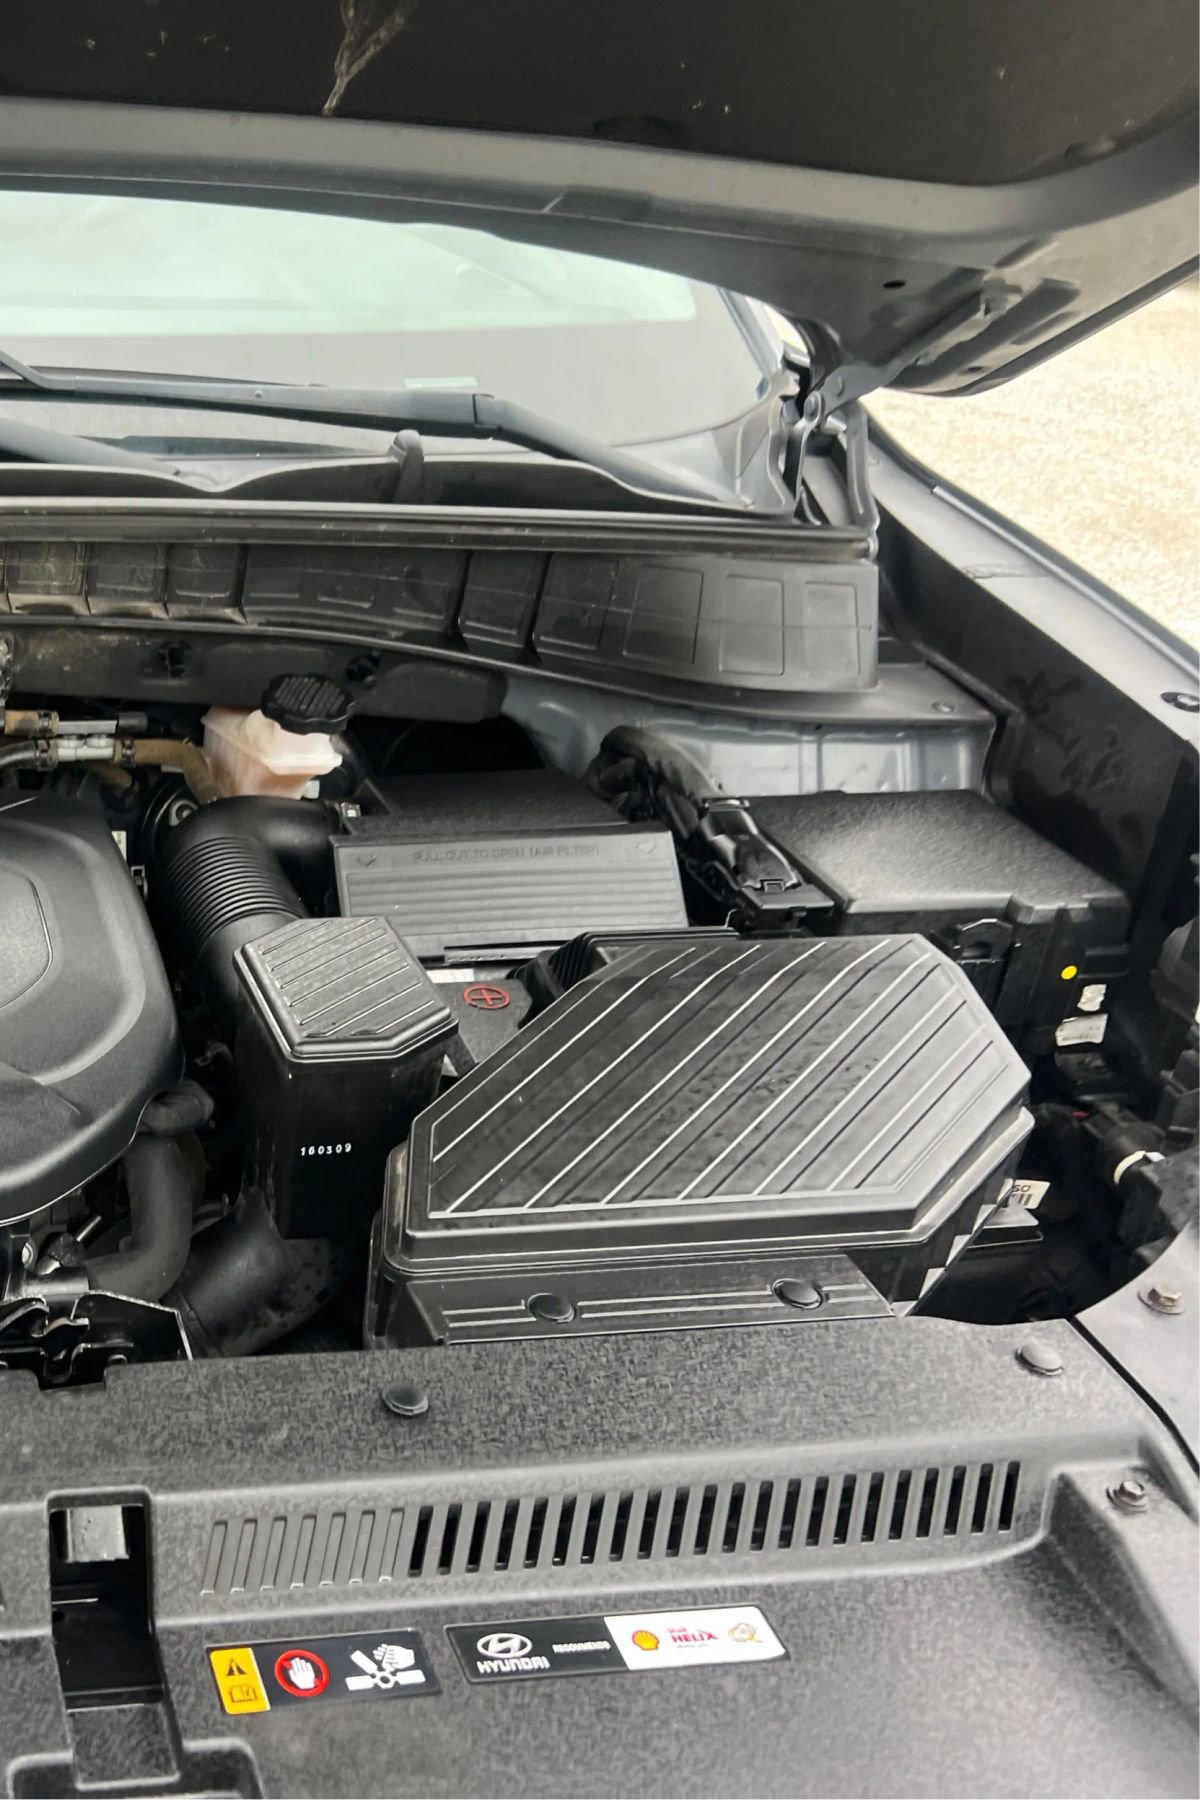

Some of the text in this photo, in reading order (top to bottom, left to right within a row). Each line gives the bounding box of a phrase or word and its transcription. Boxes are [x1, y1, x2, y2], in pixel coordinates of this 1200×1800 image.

[474, 848, 489, 859] TO
[300, 1142, 352, 1157] 160309
[671, 1631, 719, 1643] HELIX
[476, 1656, 550, 1674] HYUNDAI
